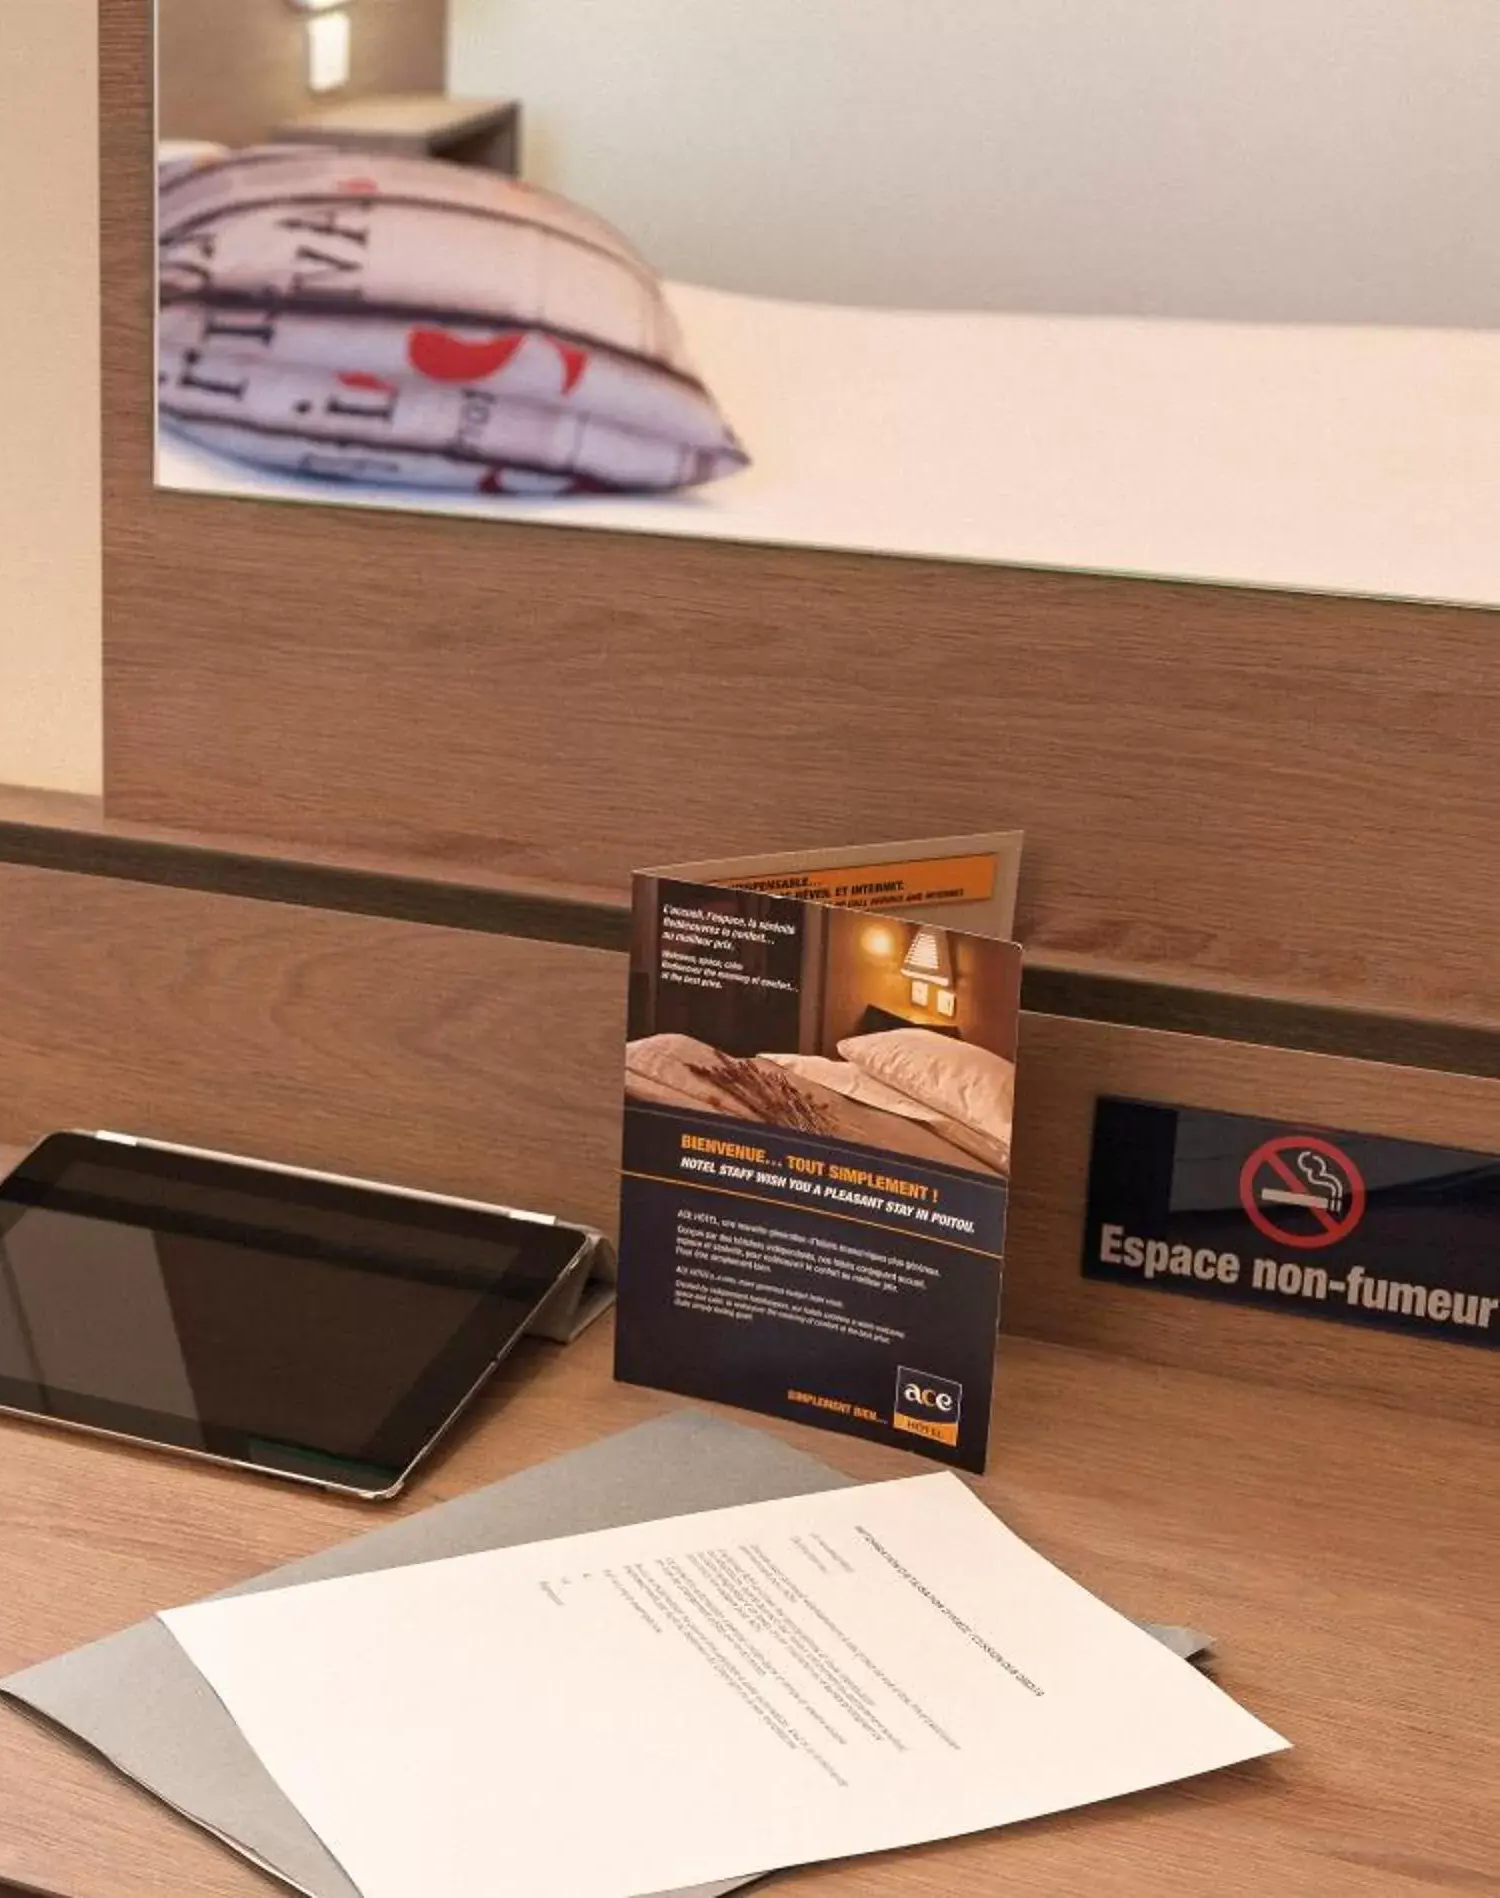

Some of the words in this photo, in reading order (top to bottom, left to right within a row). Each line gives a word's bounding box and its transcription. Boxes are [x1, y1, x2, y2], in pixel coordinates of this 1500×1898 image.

[680, 1133, 783, 1168] BIENVENUE...
[786, 1154, 826, 1177] TOUT
[829, 1164, 929, 1201] SIMPLEMENT
[680, 1156, 716, 1174] HOTEL
[718, 1163, 756, 1181] STAFF
[755, 1170, 788, 1188] WISH
[788, 1176, 814, 1194] YOU
[812, 1184, 823, 1197] A
[822, 1186, 885, 1211] PLEASANT
[884, 1200, 915, 1218] STAY
[914, 1208, 930, 1222] IN
[1099, 1223, 1241, 1286] Espace
[1252, 1257, 1500, 1329] non-fumeur
[903, 1383, 953, 1412] ace
